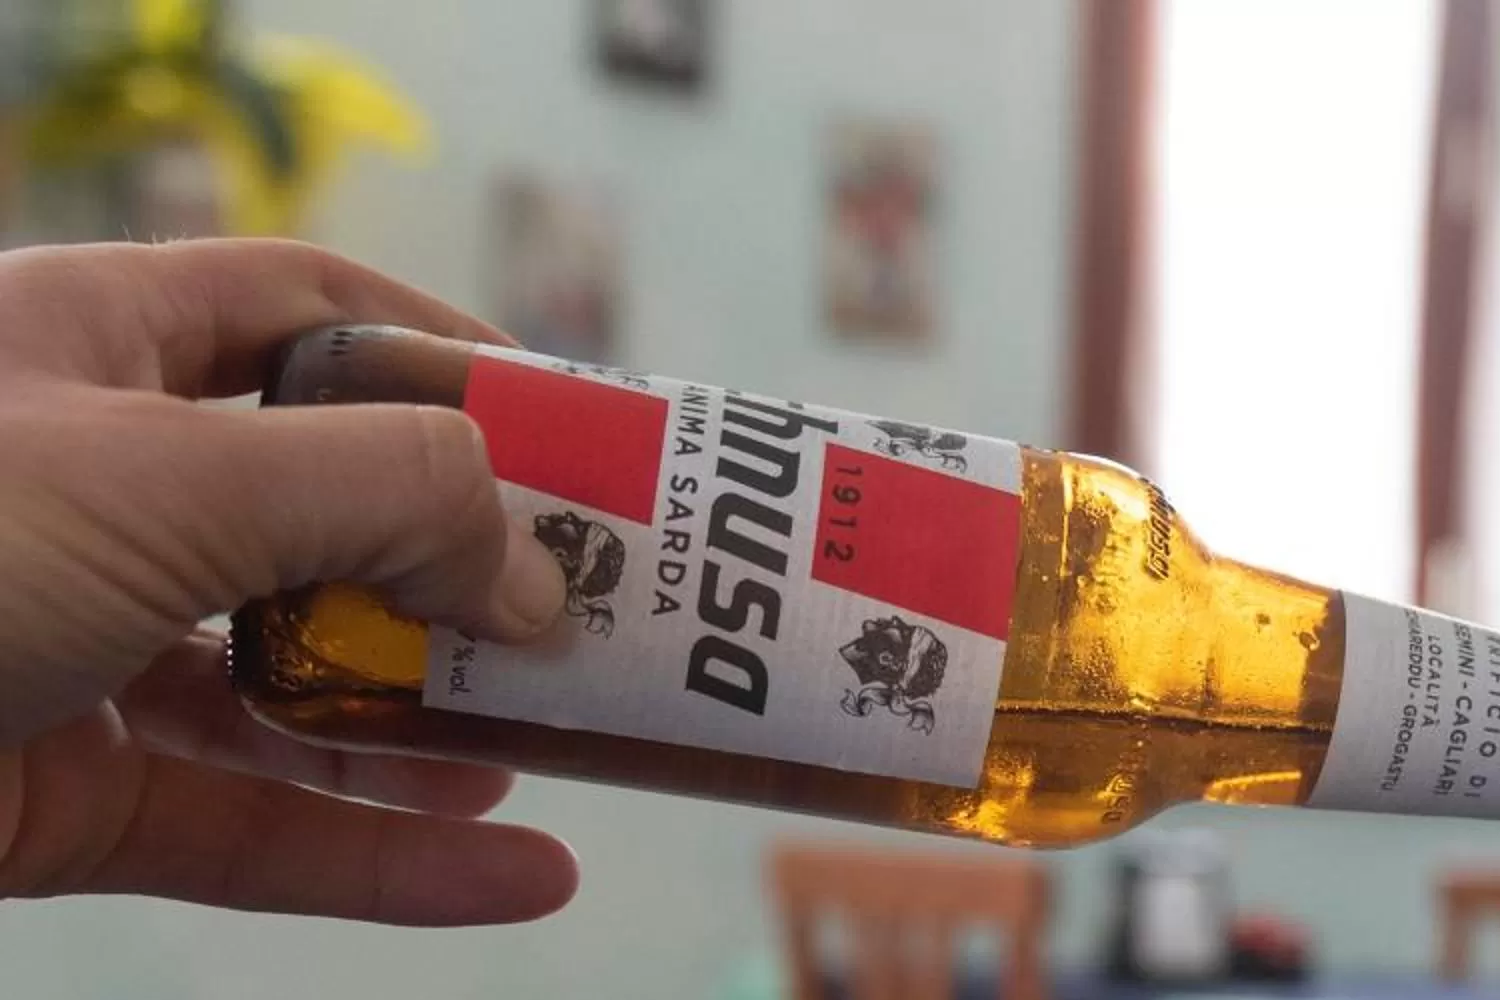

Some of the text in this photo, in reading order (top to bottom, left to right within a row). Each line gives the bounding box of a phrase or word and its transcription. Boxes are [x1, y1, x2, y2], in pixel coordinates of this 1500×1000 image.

[651, 473, 698, 616] SARDA
[685, 388, 839, 717] hnusa
[824, 465, 863, 561] 1912
[1421, 635, 1443, 727] LOCALITÀ
[1432, 695, 1472, 796] CAGLIARI
[1463, 775, 1488, 797] DI
